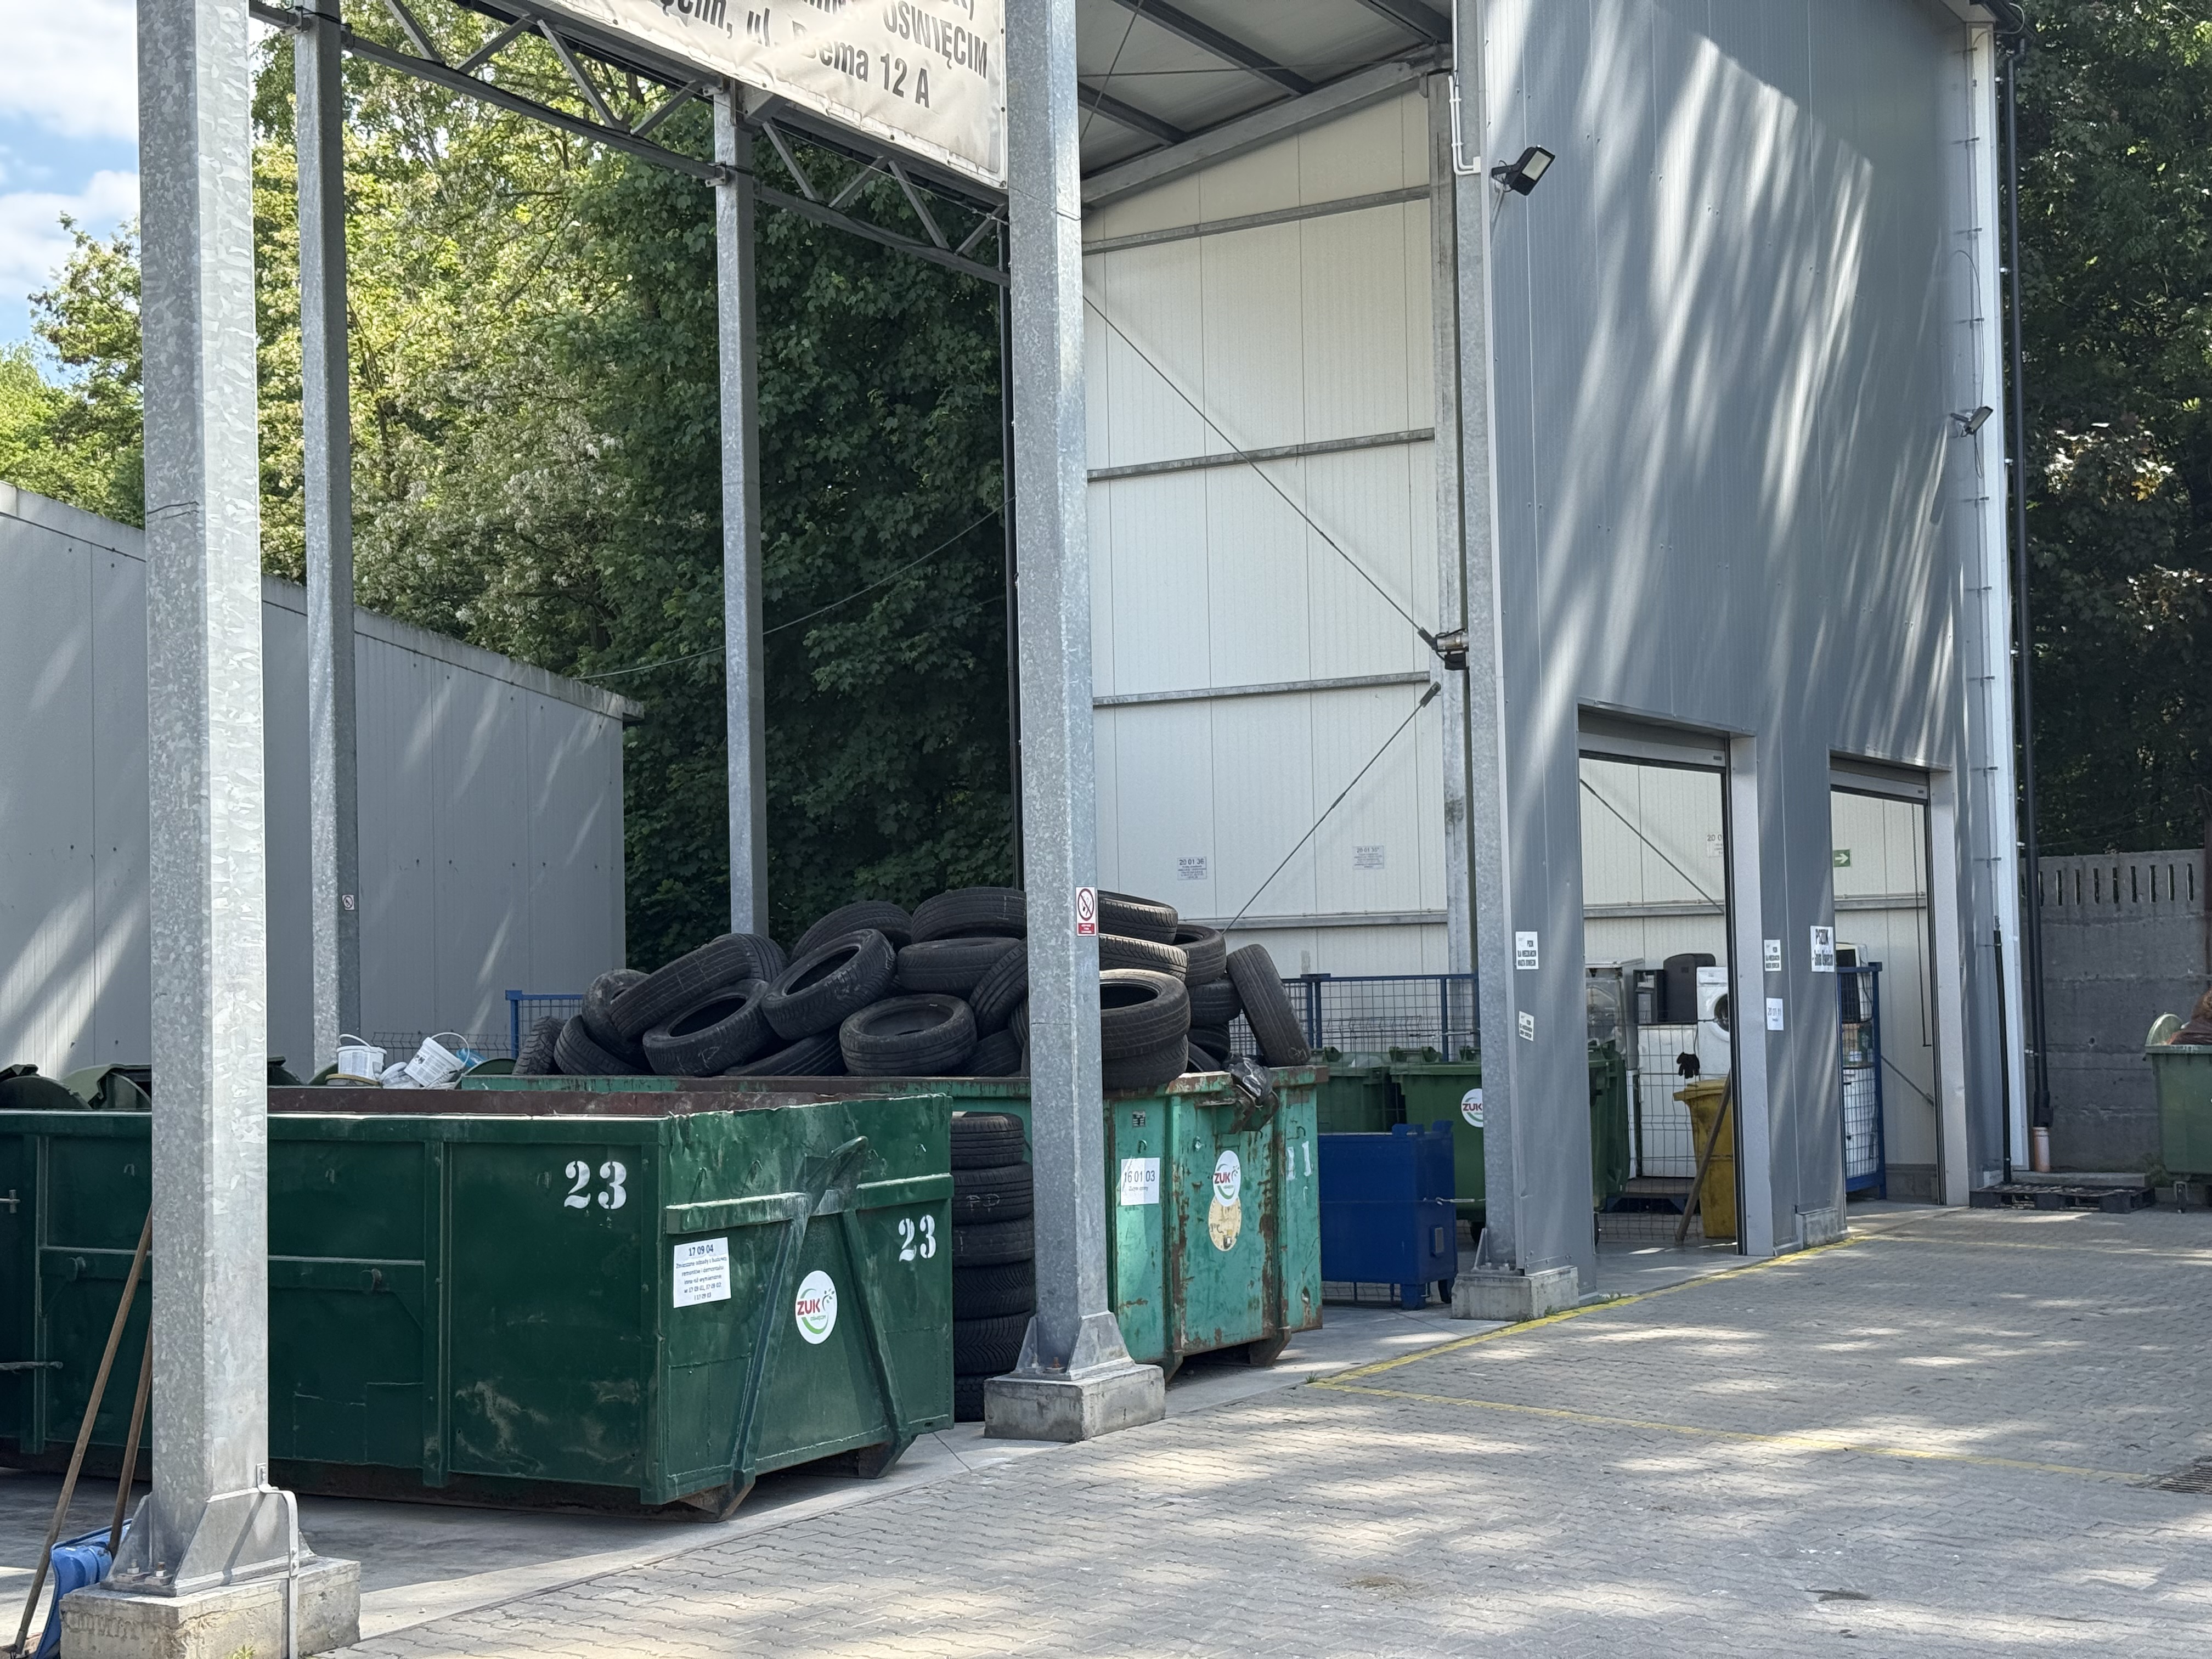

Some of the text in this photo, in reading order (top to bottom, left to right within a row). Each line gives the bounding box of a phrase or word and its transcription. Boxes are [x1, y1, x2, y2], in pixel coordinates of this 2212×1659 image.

[880, 53, 907, 98] 12
[915, 67, 929, 109] A
[1462, 1103, 1483, 1111] ZUK
[1125, 1170, 1155, 1183] 16 01 03
[1214, 1172, 1231, 1184] ZUK
[564, 1160, 627, 1210] 23
[899, 1215, 936, 1262] 23
[689, 1244, 714, 1256] 17 09 04
[797, 1298, 821, 1316] ZUK
